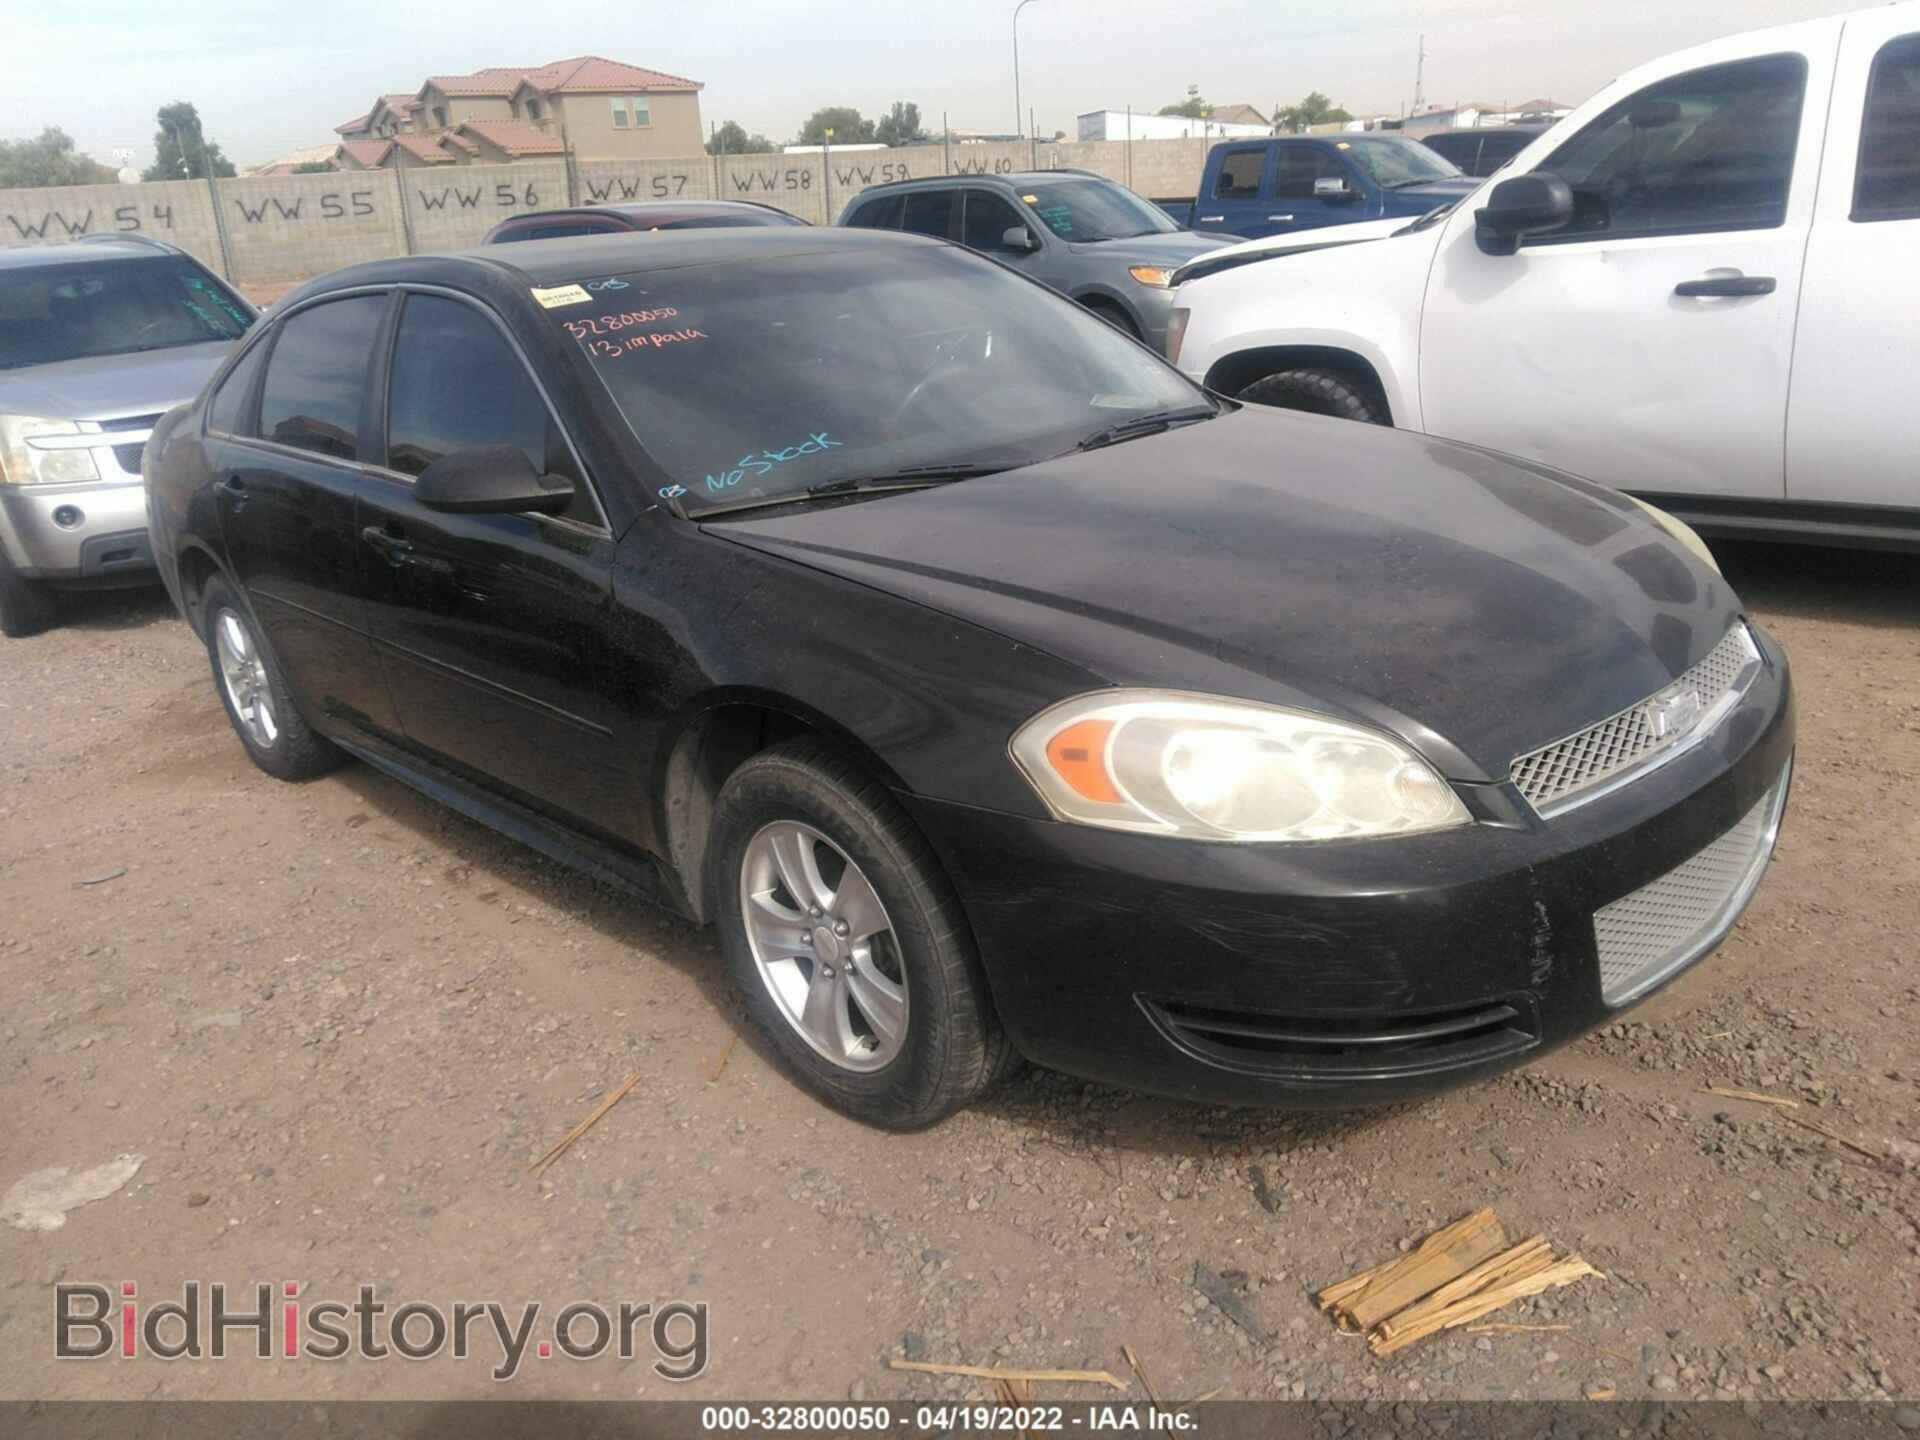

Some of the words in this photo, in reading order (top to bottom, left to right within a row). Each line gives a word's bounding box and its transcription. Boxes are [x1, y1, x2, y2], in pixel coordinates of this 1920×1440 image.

[835, 166, 877, 186] WW
[881, 163, 911, 184] 59
[954, 157, 988, 176] WW
[585, 178, 642, 202] WW
[651, 174, 689, 197] 57
[732, 171, 779, 193] WW
[785, 169, 812, 191] 58
[234, 197, 302, 224] WW
[319, 190, 375, 219] 55
[418, 185, 482, 211] WW
[496, 182, 540, 208] 56
[7, 209, 93, 239] WW
[115, 205, 173, 232] 54
[562, 306, 679, 339] 32800050
[588, 339, 623, 358] 13
